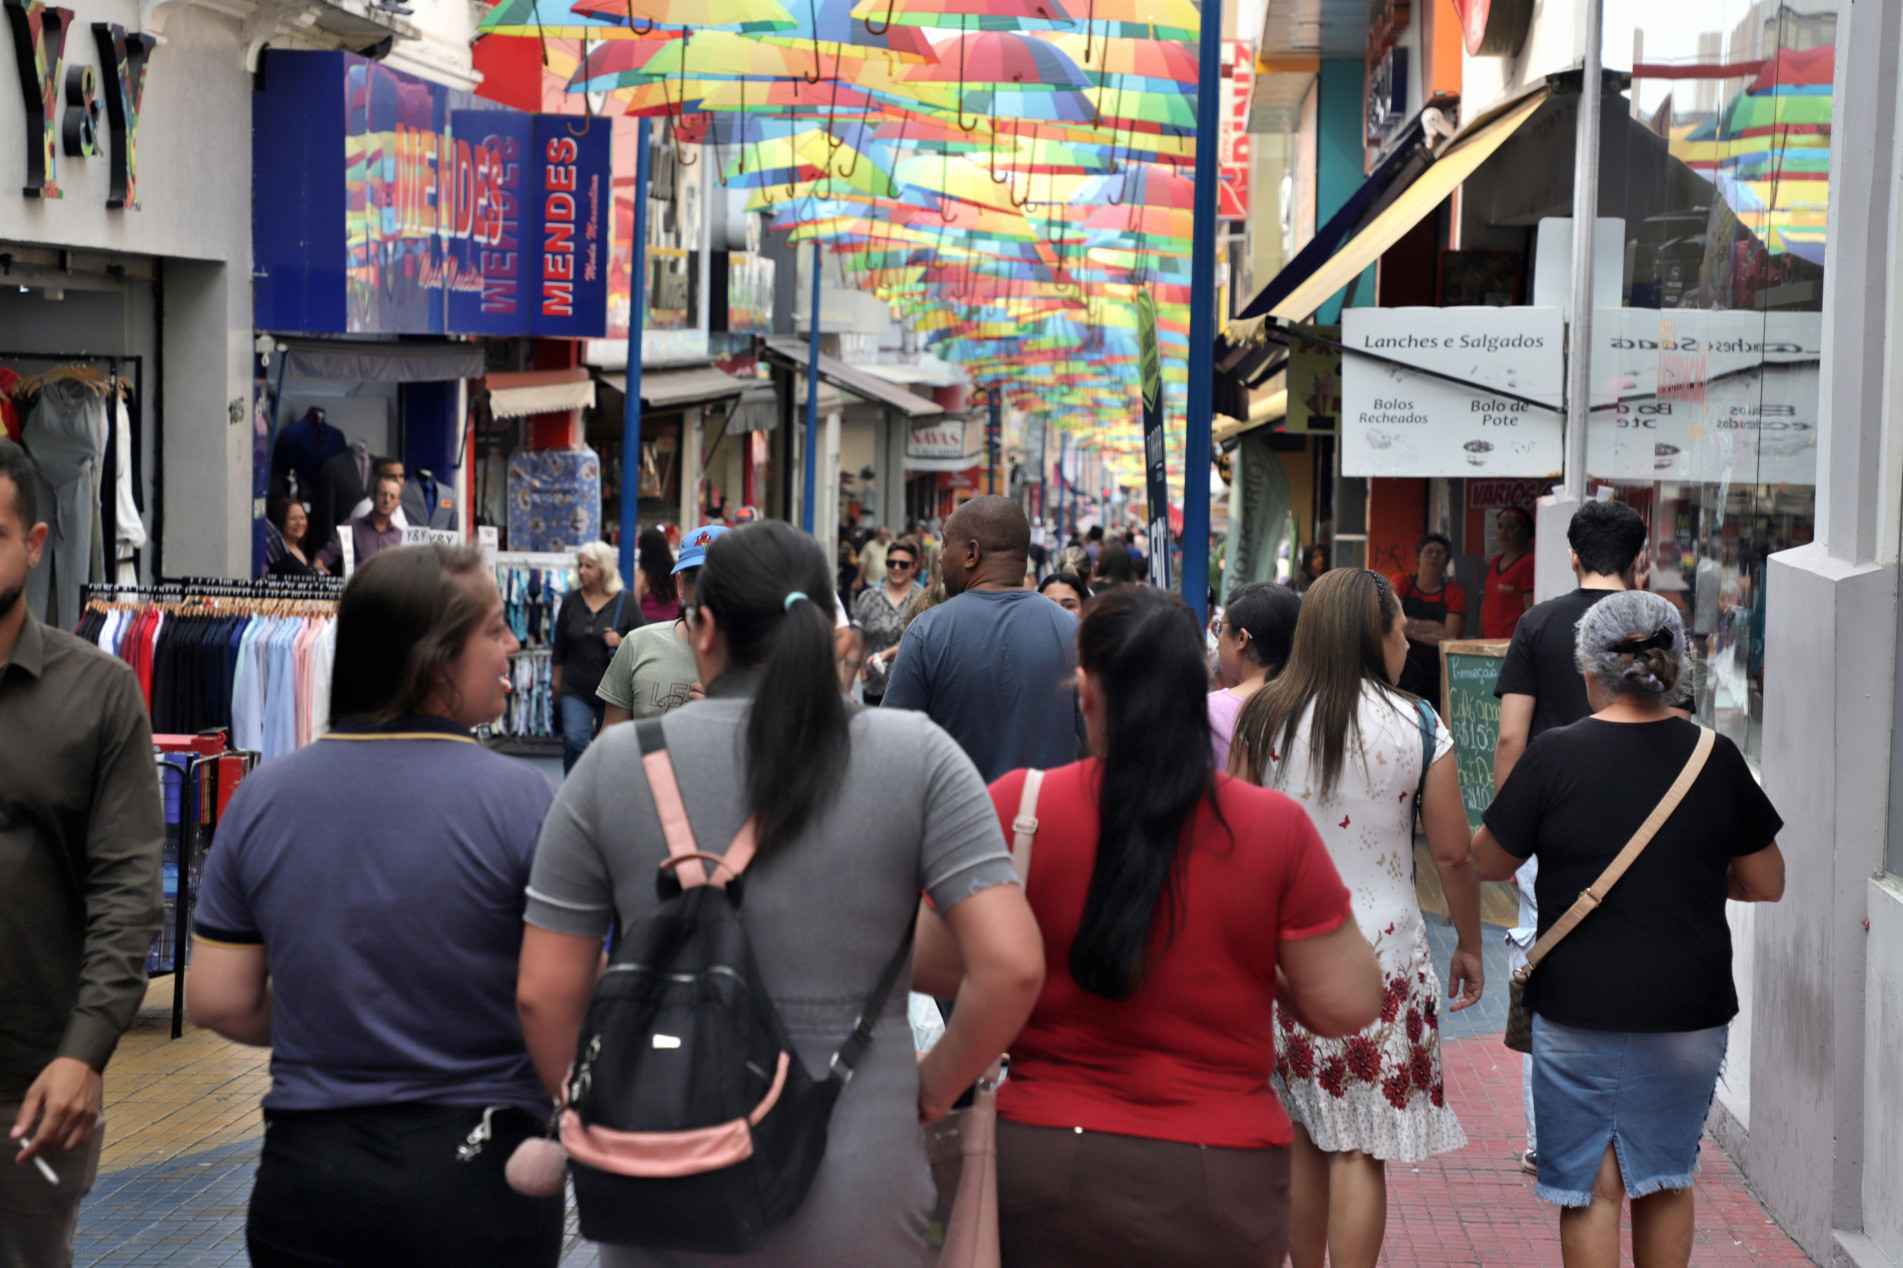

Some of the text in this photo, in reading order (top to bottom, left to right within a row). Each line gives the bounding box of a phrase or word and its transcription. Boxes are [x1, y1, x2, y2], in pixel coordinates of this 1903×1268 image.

[396, 121, 503, 246] MENDES
[542, 136, 578, 317] MENDES
[1364, 334, 1545, 351] Lanches e Salgados
[1373, 398, 1414, 411] Bolos
[1470, 400, 1529, 413] Bolo de
[1358, 412, 1429, 425] Recheados
[1482, 414, 1519, 427] Pote
